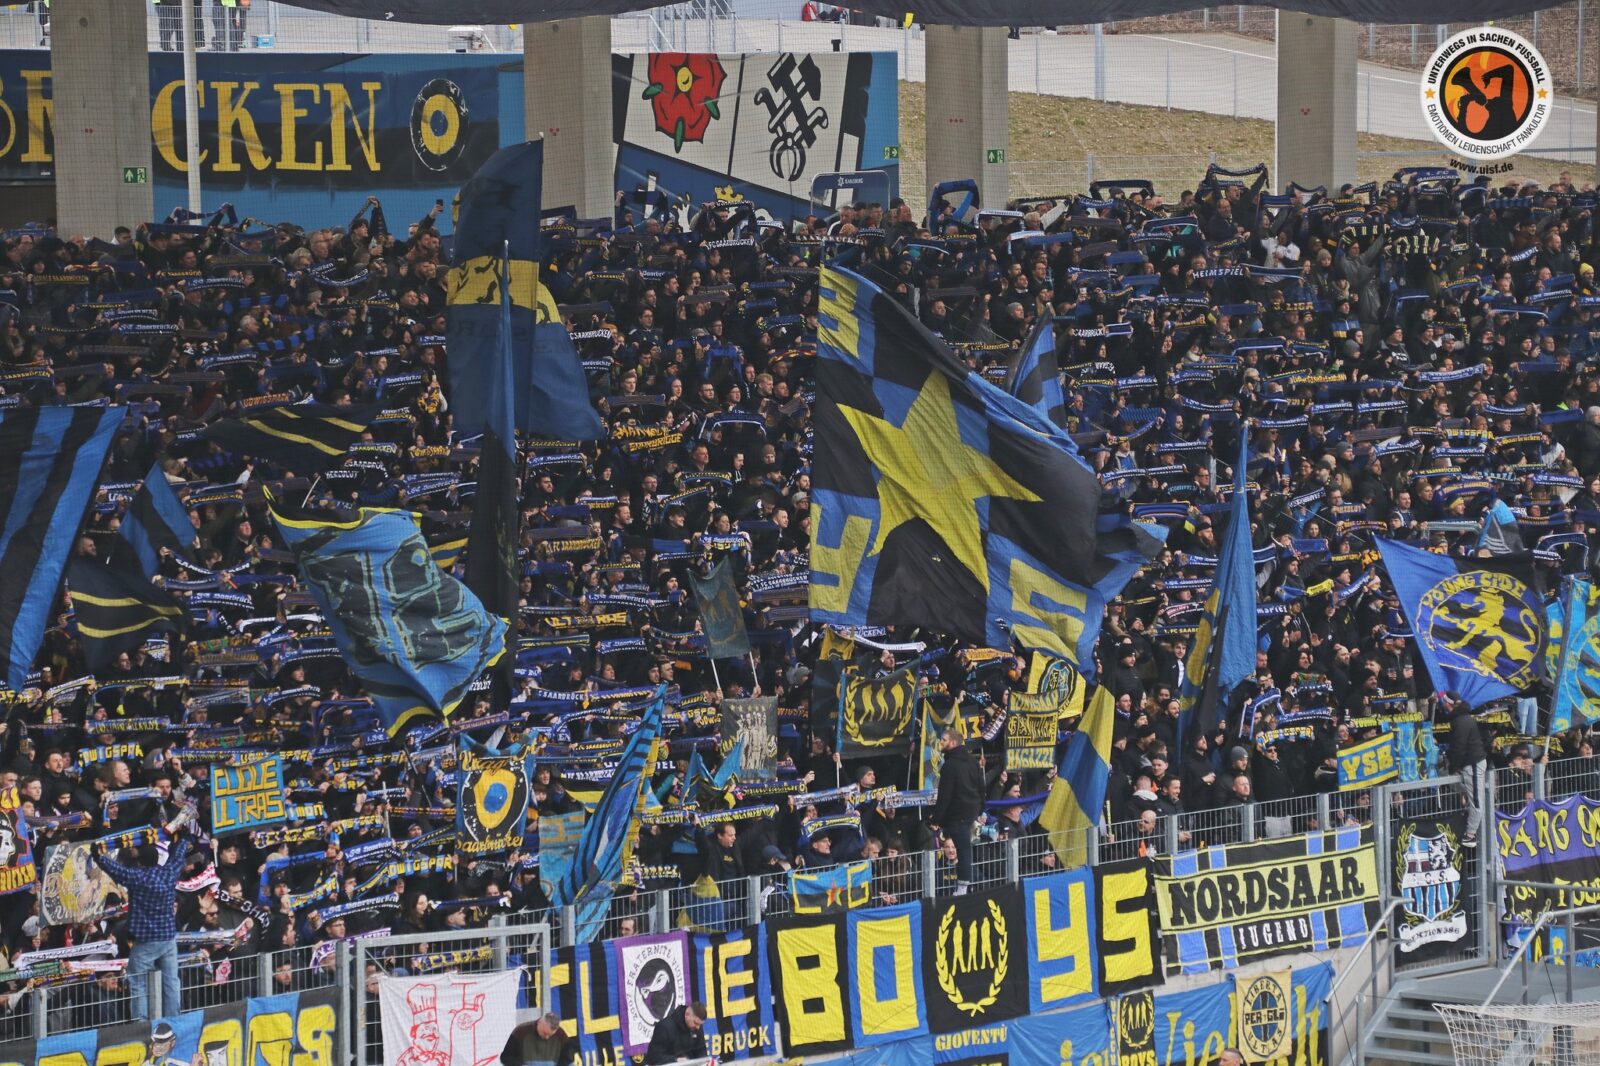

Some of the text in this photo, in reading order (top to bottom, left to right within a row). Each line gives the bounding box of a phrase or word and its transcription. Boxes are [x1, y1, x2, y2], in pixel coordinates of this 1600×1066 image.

[1192, 267, 1244, 280] HEIMSPIEL
[1286, 301, 1314, 311] LIGA
[1422, 575, 1476, 608] YOUNG
[213, 759, 279, 797] CLIQUE
[1341, 744, 1395, 782] YSB
[213, 789, 286, 829] ULTRAS
[1498, 806, 1568, 858] SARG
[1168, 856, 1365, 927] NORDSAAR
[1238, 916, 1309, 950] JUGEND
[1244, 1013, 1263, 1025] PER
[1247, 1029, 1283, 1054] ULTAS
